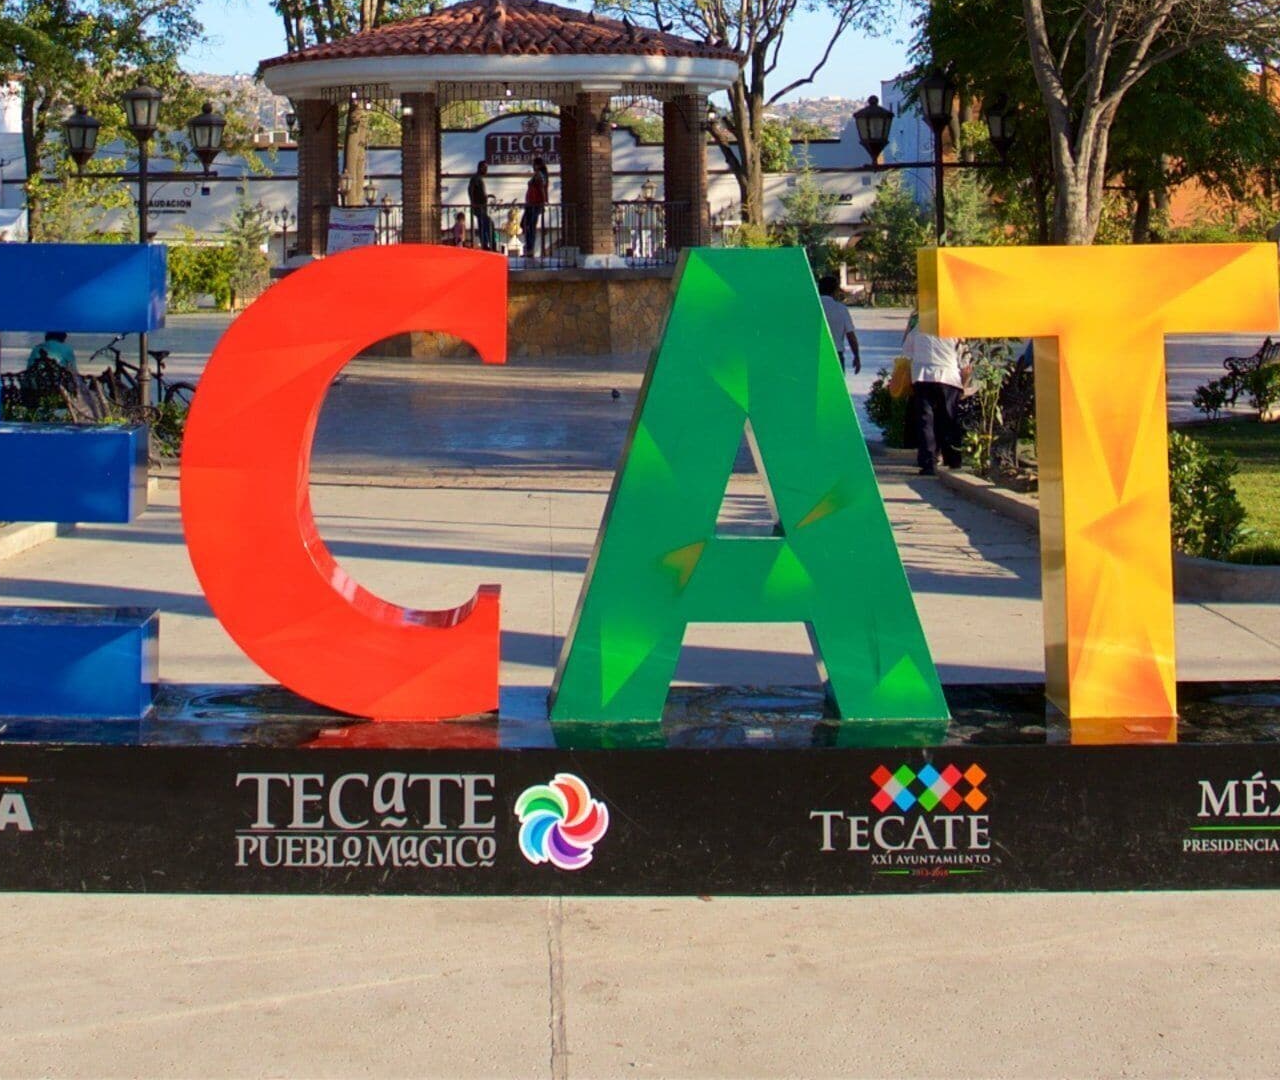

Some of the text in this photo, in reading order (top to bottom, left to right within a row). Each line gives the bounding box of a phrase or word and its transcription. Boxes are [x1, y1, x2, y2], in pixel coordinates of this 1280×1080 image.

[1182, 838, 1277, 852] PRESIDENCIA
[871, 854, 991, 865] XXI AYUNTAMIENTO
